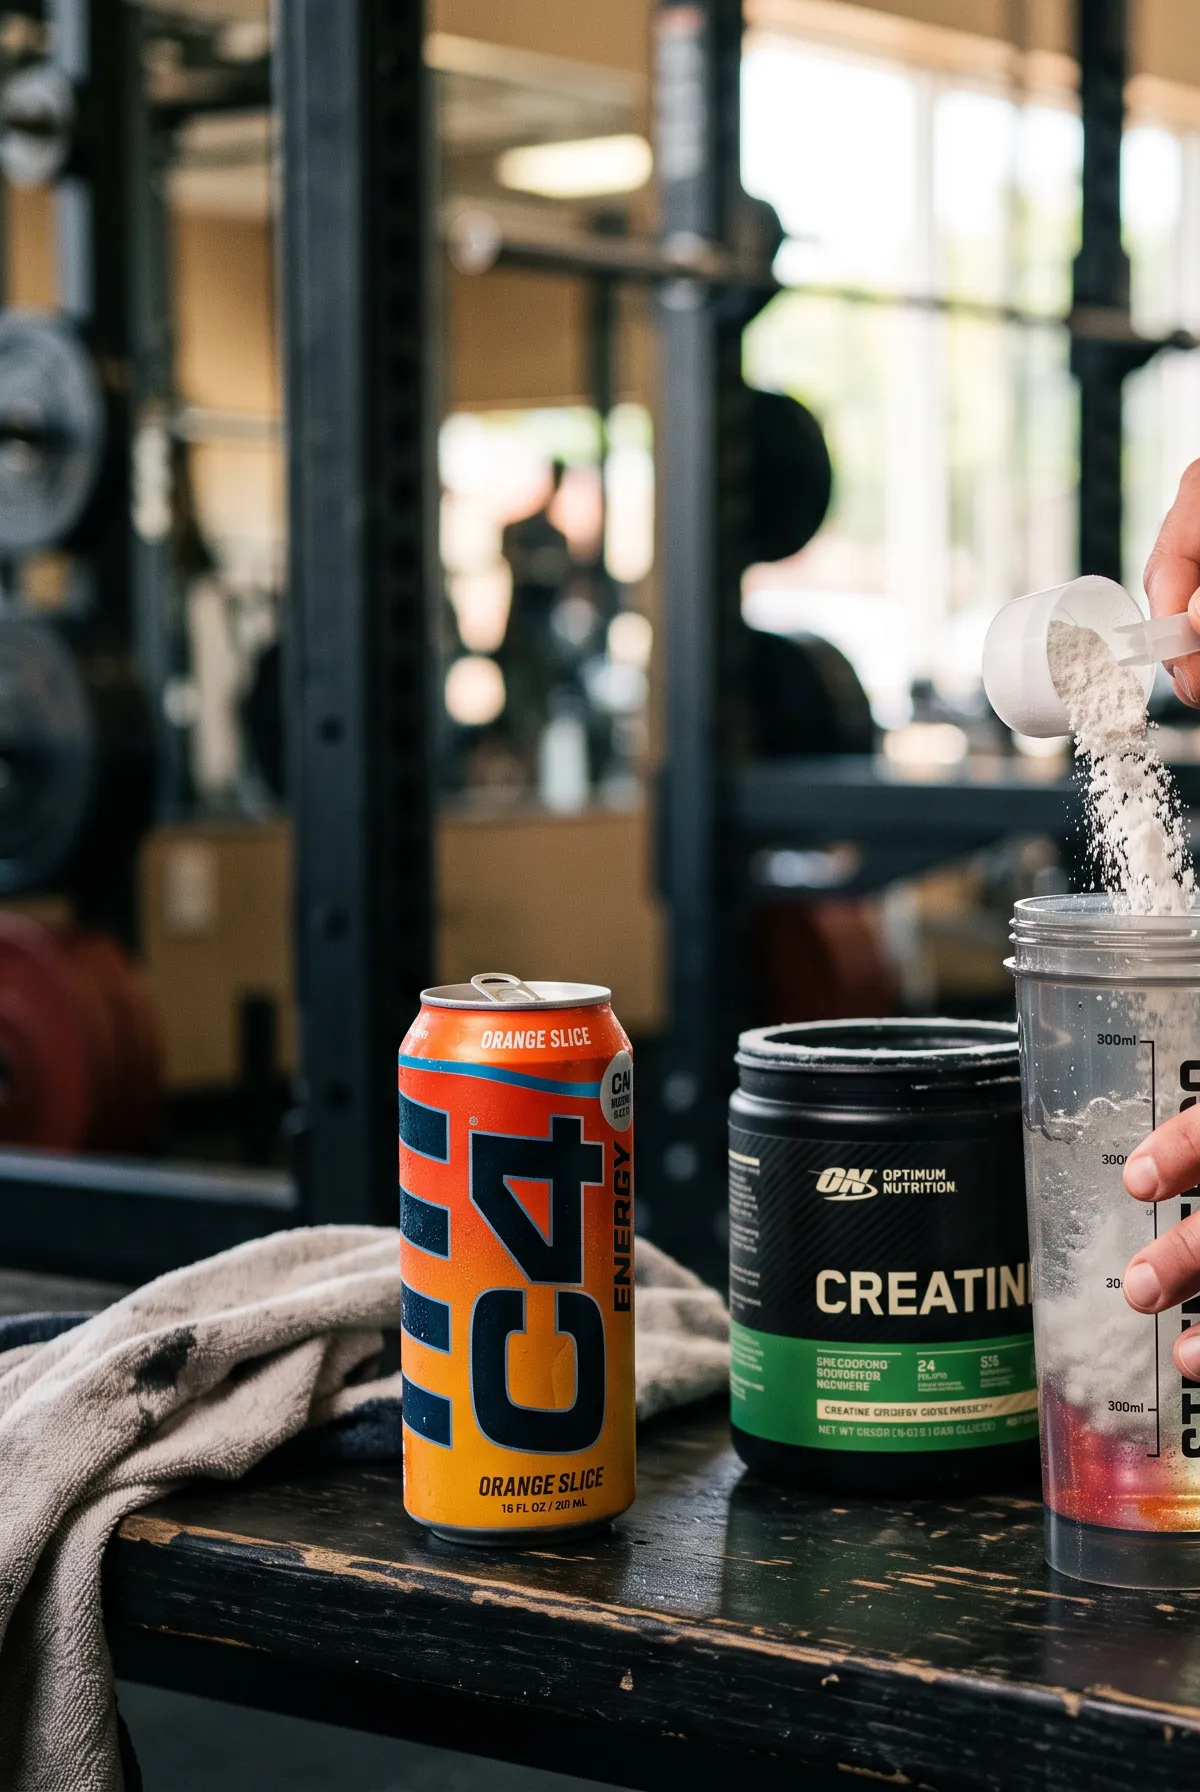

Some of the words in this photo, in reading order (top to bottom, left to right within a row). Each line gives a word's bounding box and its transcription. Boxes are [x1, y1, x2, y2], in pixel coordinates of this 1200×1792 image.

[481, 1030, 546, 1049] ORANGE
[550, 1027, 591, 1047] SLICE
[1097, 1034, 1136, 1046] 300ml
[1101, 1154, 1128, 1166] 300
[815, 1167, 875, 1195] ON
[882, 1168, 947, 1181] OPTIMUM
[882, 1181, 956, 1194] NUTRITION
[613, 1140, 631, 1312] ENERGY
[469, 1114, 606, 1455] C4
[917, 1359, 936, 1373] 24
[824, 1405, 870, 1417] CREATINE
[1107, 1401, 1144, 1413] 300ml
[818, 1424, 837, 1435] NET
[839, 1426, 854, 1436] WT
[478, 1473, 556, 1497] ORANGE
[558, 1466, 605, 1494] SLICE
[516, 1503, 529, 1513] FL
[531, 1502, 546, 1513] OZ
[572, 1497, 588, 1509] ML
